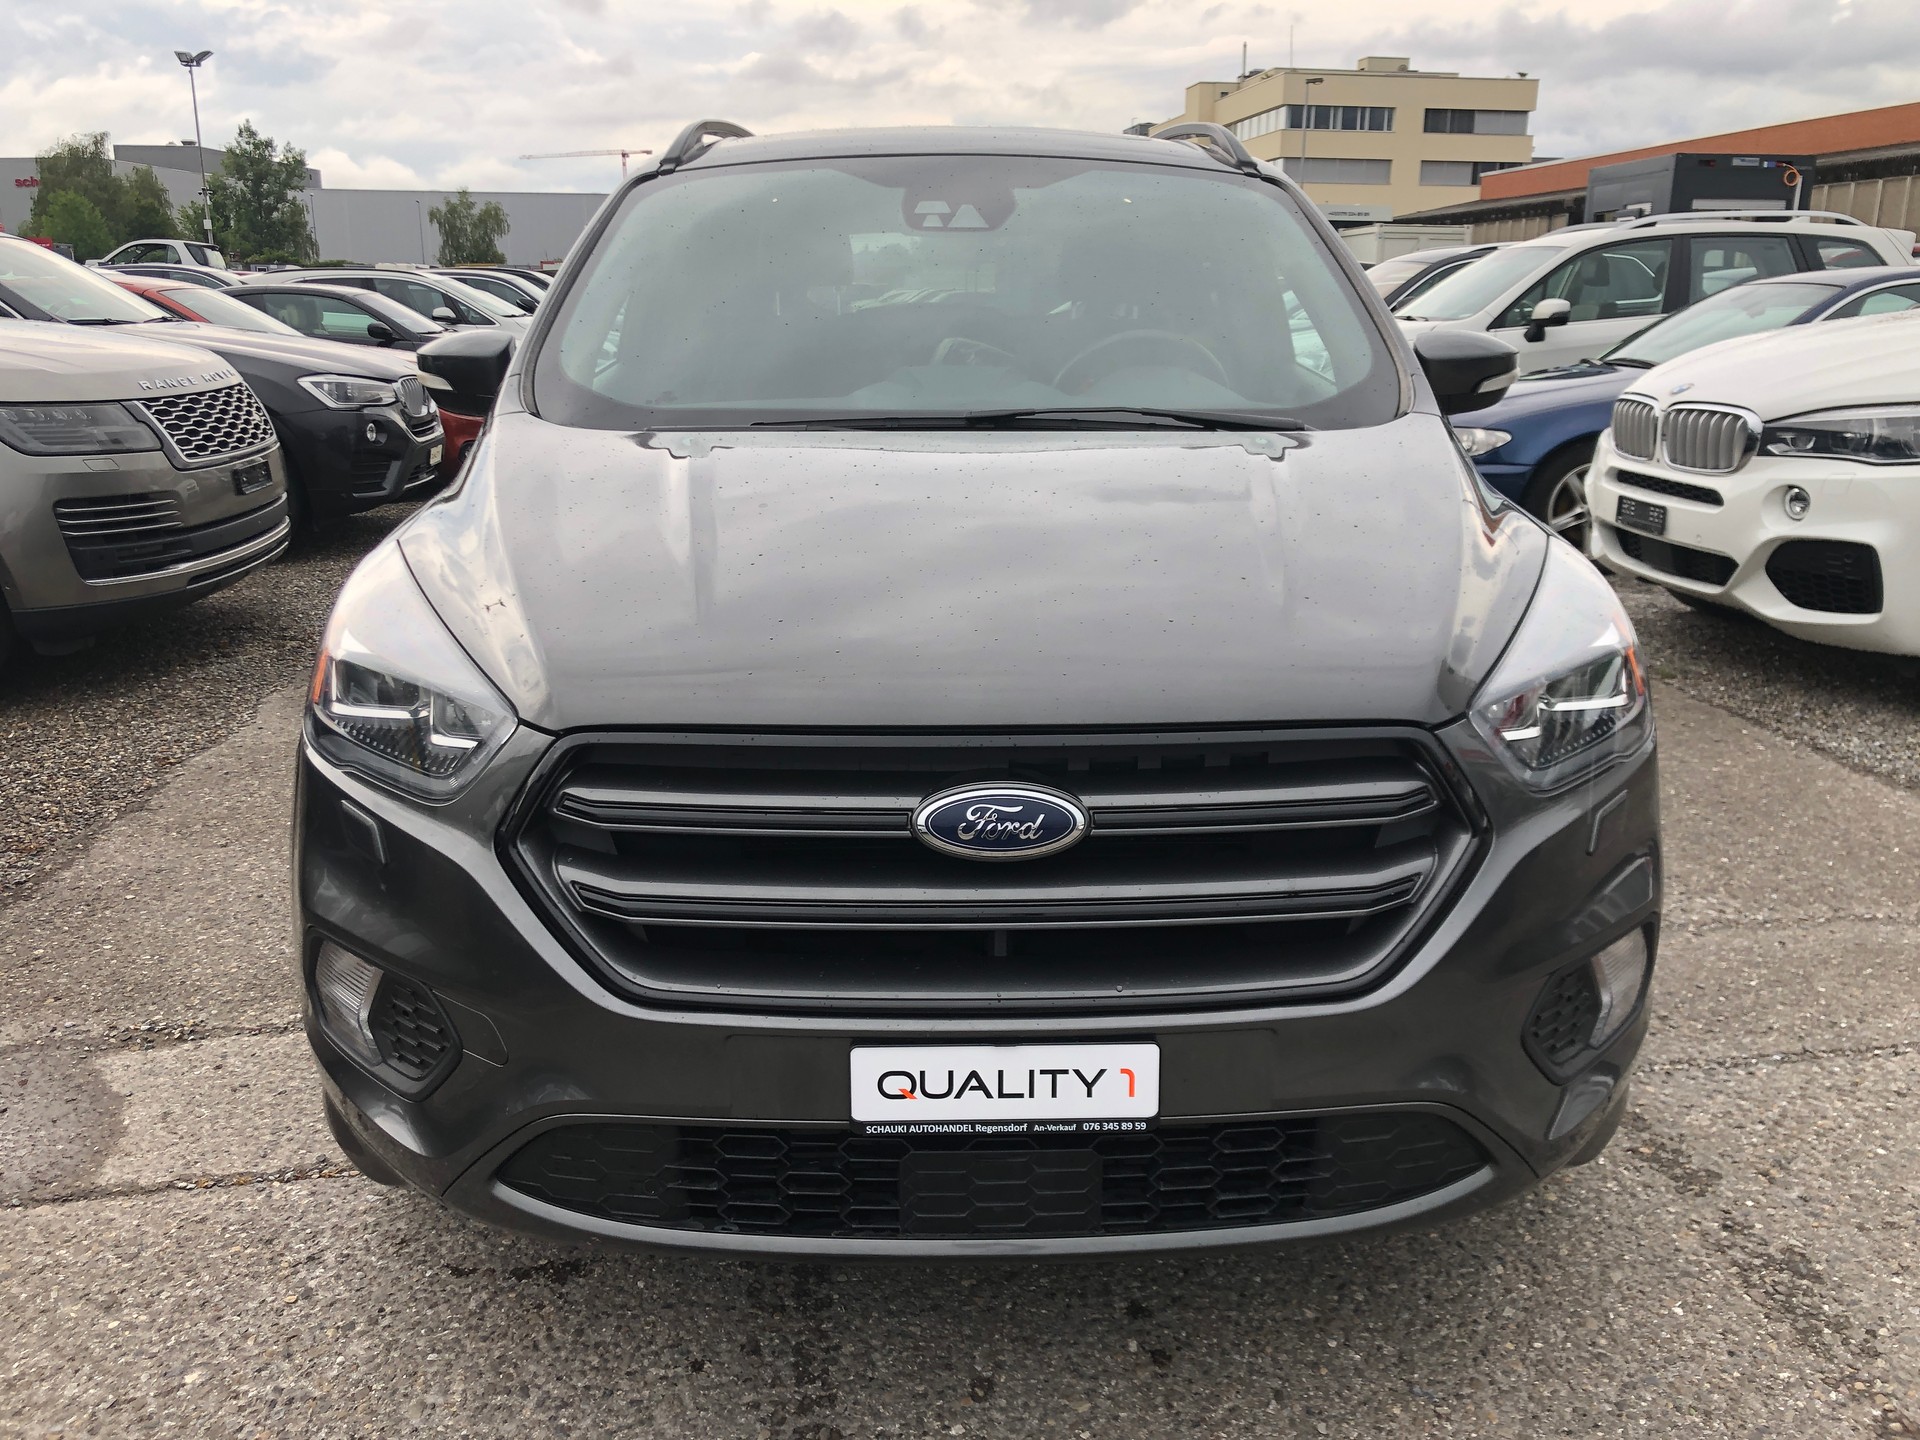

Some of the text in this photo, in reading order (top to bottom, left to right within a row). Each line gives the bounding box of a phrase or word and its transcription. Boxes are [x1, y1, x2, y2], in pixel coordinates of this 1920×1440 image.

[137, 376, 199, 391] RANGE
[957, 803, 1046, 840] Ford
[877, 1068, 1135, 1100] QUALITY 1
[866, 1121, 1147, 1134] SCHAUKI AUTOHANDEL Regensdorf An-Verkauf 076 345 89 59
